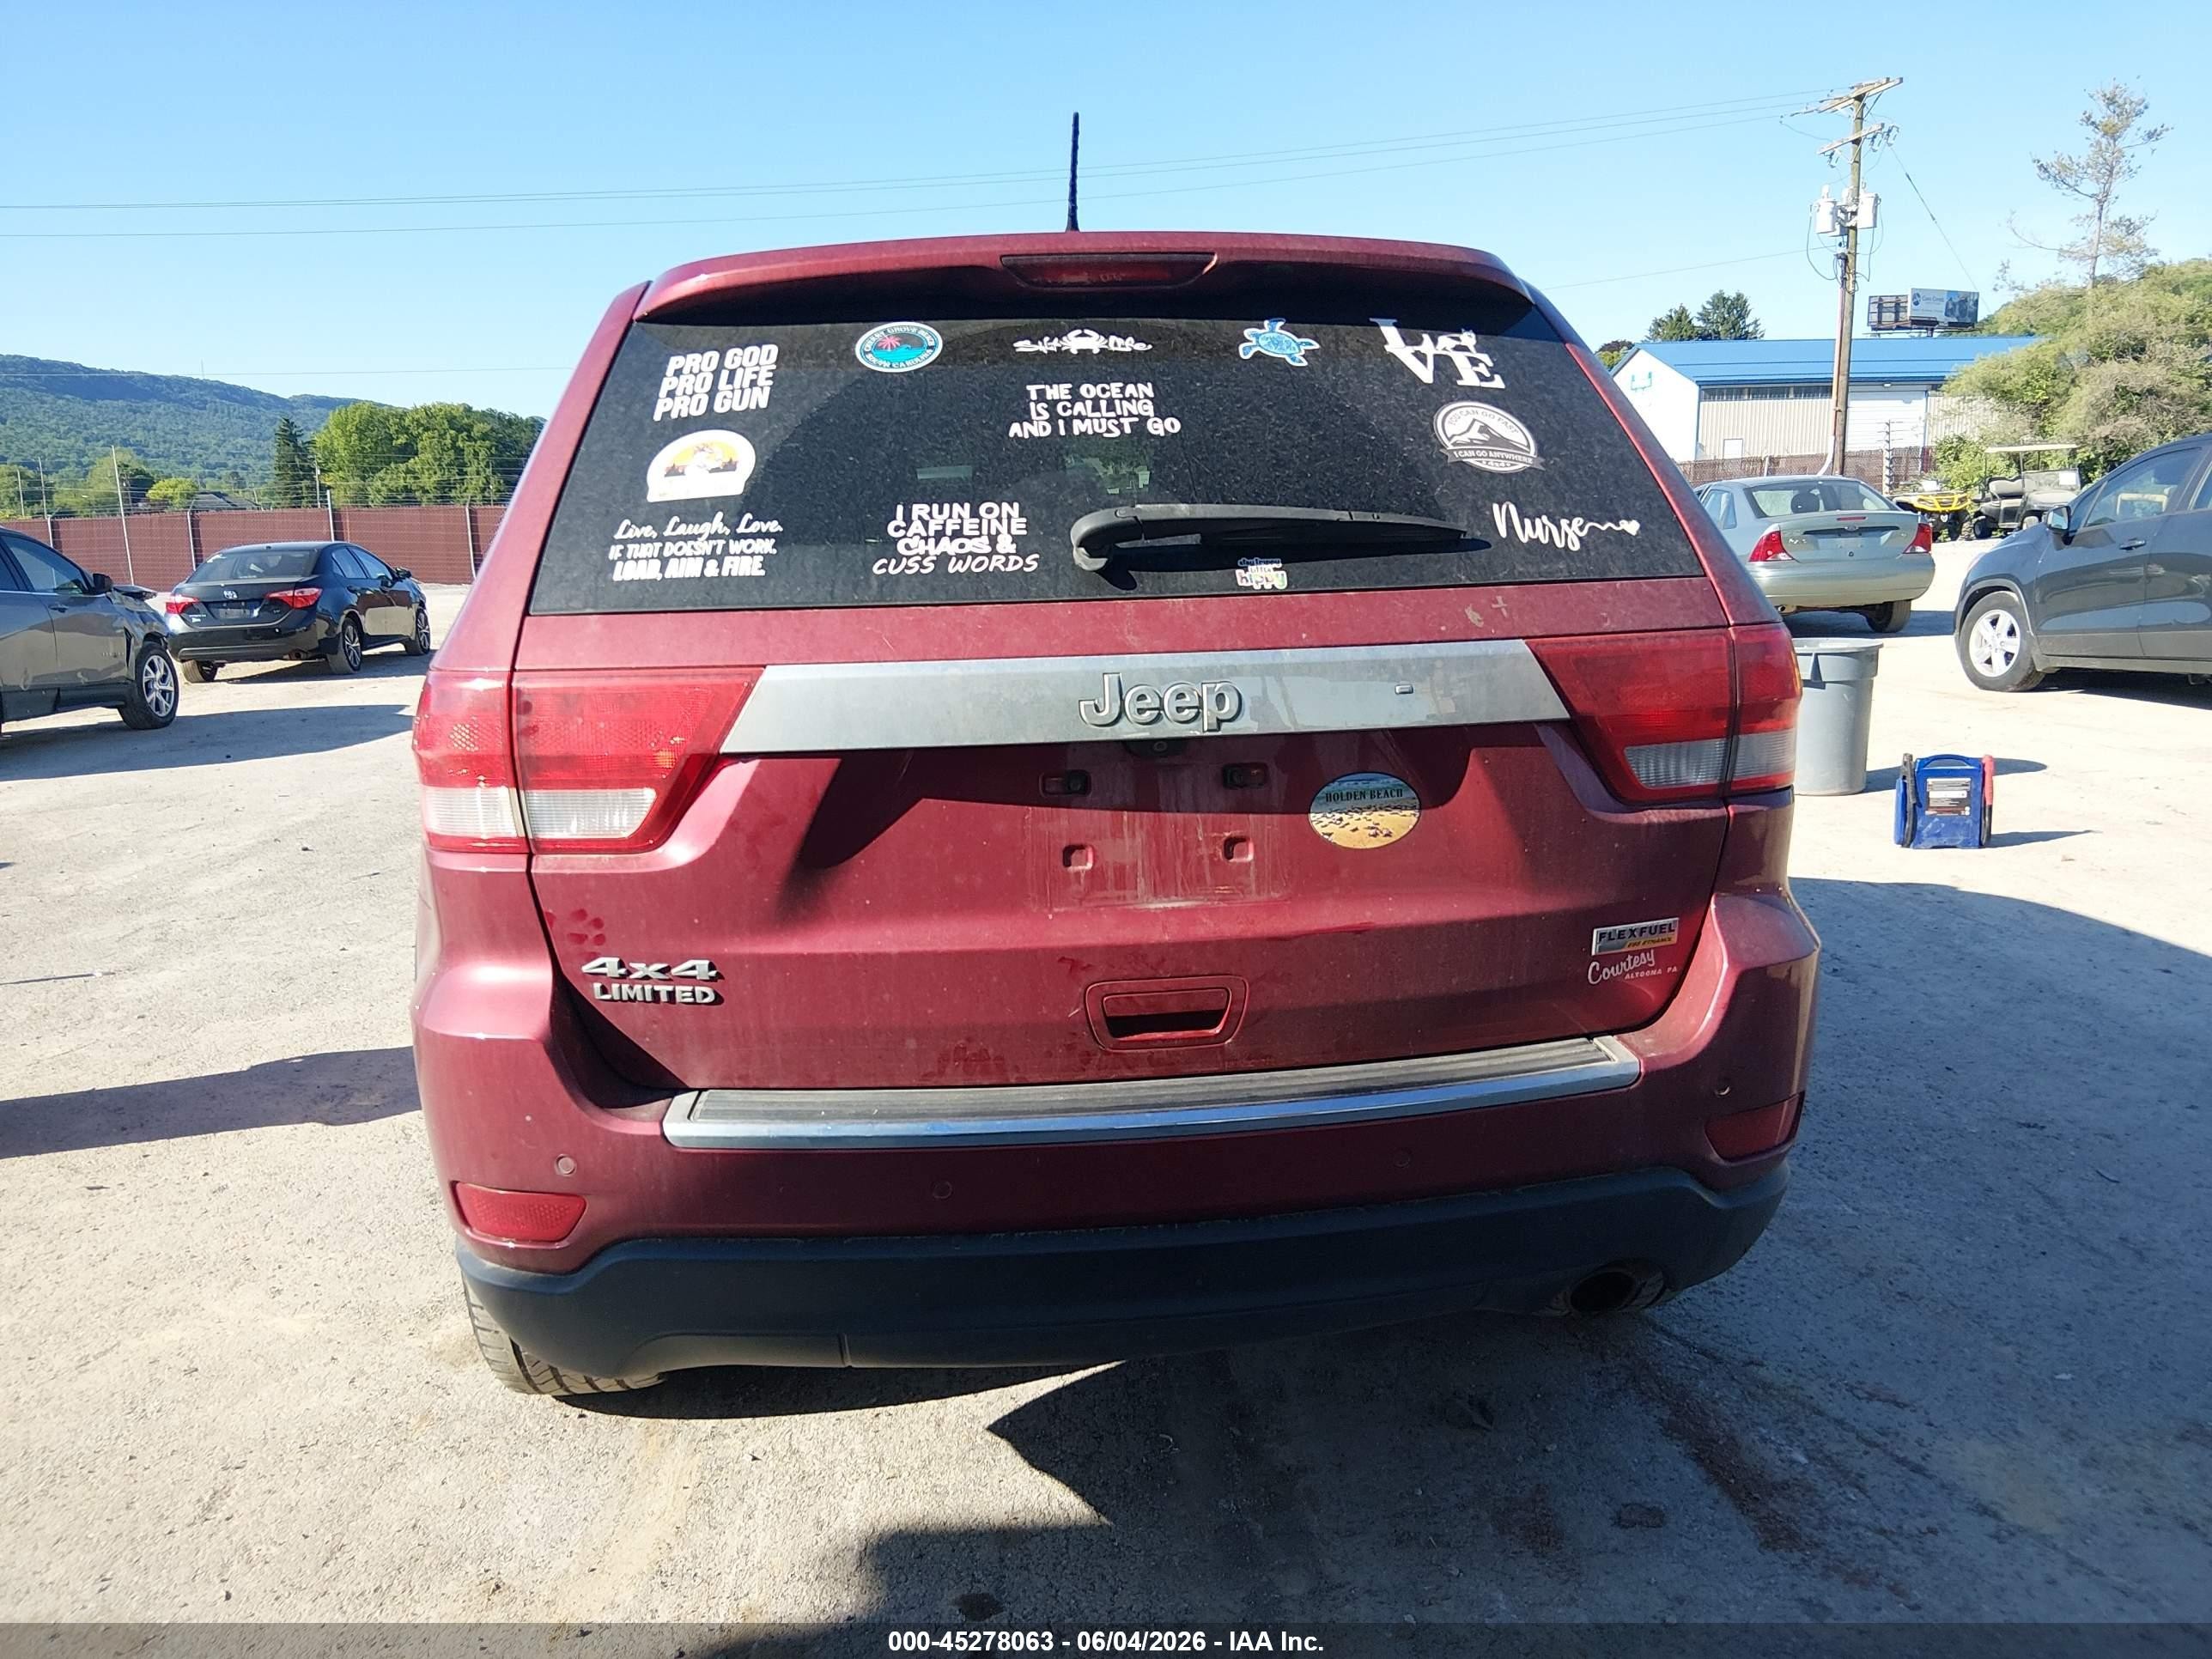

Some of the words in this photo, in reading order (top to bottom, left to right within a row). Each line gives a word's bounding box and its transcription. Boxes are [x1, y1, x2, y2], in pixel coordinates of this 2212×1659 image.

[666, 350, 719, 377] PRO
[723, 343, 779, 368] GOD
[659, 372, 713, 398] PRO
[717, 365, 777, 392] LIFE
[1026, 383, 1073, 400] THE
[1079, 382, 1154, 399] OCEAN
[653, 392, 708, 422] PRO
[714, 386, 771, 414] GUN
[1030, 402, 1050, 420] IS
[1056, 398, 1154, 417] CALLING
[1480, 411, 1496, 420] GO
[1008, 421, 1052, 439] AND
[1058, 418, 1066, 436] I
[1073, 417, 1139, 438] MUST
[1146, 417, 1182, 437] GO
[1488, 452, 1534, 465] ANYWHERE
[896, 504, 904, 521] I
[911, 502, 971, 521] RUN
[978, 501, 1020, 520] ON
[613, 519, 659, 539] Live,
[663, 511, 731, 542] Laugh,
[887, 517, 1028, 538] CAFFEINE
[1493, 502, 1589, 550] Nurse
[608, 544, 625, 560] IF
[626, 542, 664, 559] THAT
[663, 539, 726, 557] DOESN'T
[896, 534, 993, 556] CHAOS
[995, 532, 1017, 554] &
[665, 557, 704, 579] AIM
[704, 559, 720, 577] &
[872, 556, 938, 574] CUSS
[947, 554, 1041, 574] WORDS
[1237, 570, 1286, 589] hippy
[1079, 672, 1243, 732] Jeep
[1325, 792, 1367, 802] HOLDEN
[1370, 788, 1403, 800] BEACH
[1598, 922, 1676, 942] FLEXFUEL
[581, 957, 718, 981] 4x4
[1588, 949, 1656, 985] Courtesy
[1624, 969, 1662, 980] ALTOONA
[592, 981, 716, 1004] LIMITED
